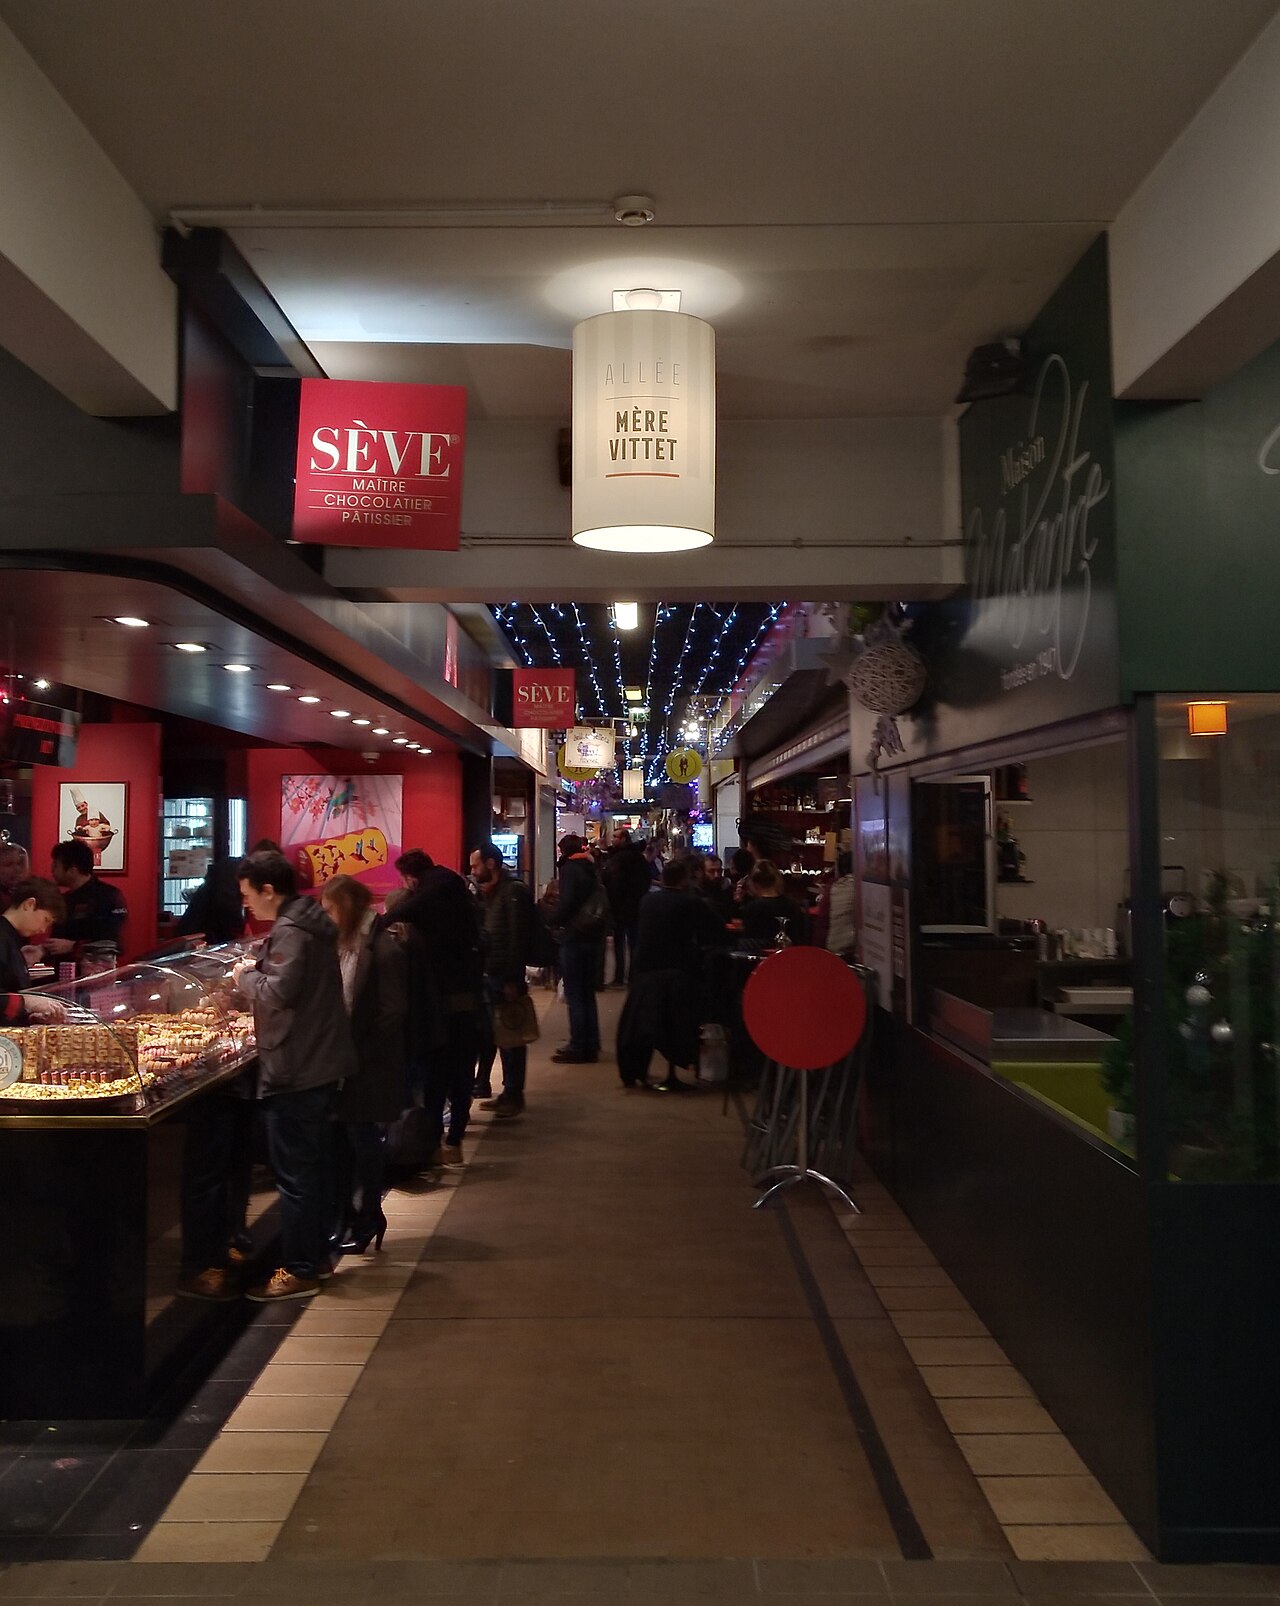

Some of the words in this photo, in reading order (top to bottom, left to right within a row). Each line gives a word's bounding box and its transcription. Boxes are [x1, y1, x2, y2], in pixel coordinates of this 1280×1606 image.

[605, 356, 681, 386] ALLÉE
[616, 405, 669, 433] MÈRE
[609, 437, 678, 461] VITTET
[352, 478, 406, 493] MAÎTRE
[324, 493, 433, 511] CHOCOLATIER
[342, 510, 412, 526] PÂTISSIER
[517, 682, 571, 703] SÈVE
